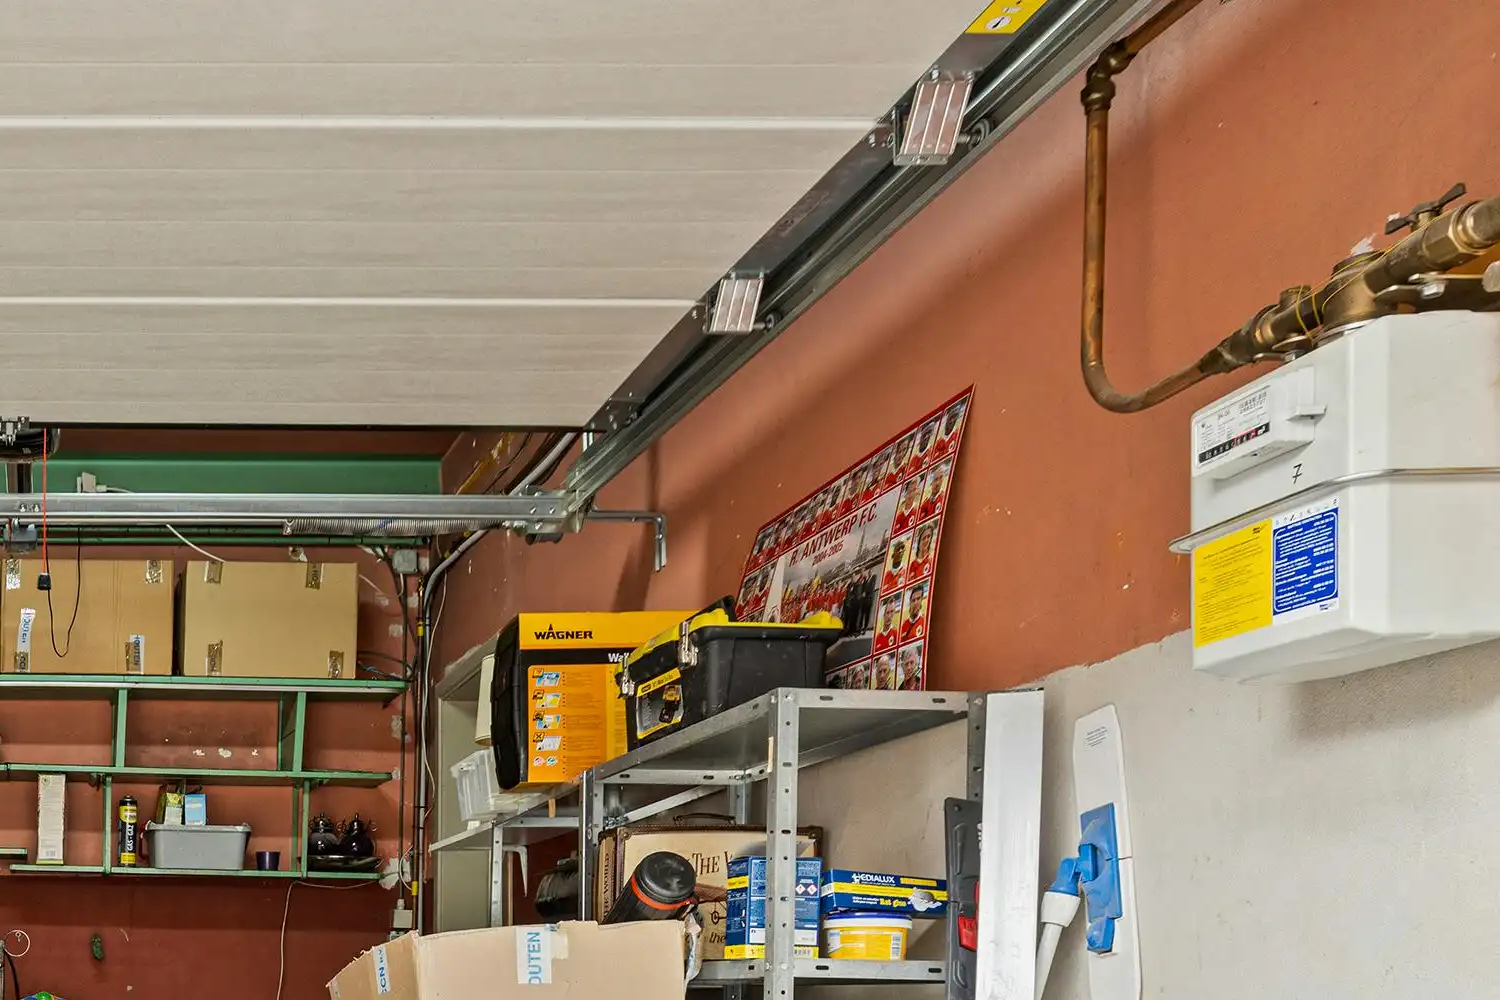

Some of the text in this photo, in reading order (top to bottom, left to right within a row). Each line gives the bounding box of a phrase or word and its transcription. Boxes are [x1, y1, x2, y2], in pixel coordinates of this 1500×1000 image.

[802, 516, 858, 560] ANTWERP
[534, 624, 594, 640] WAGNER
[691, 852, 720, 878] THE
